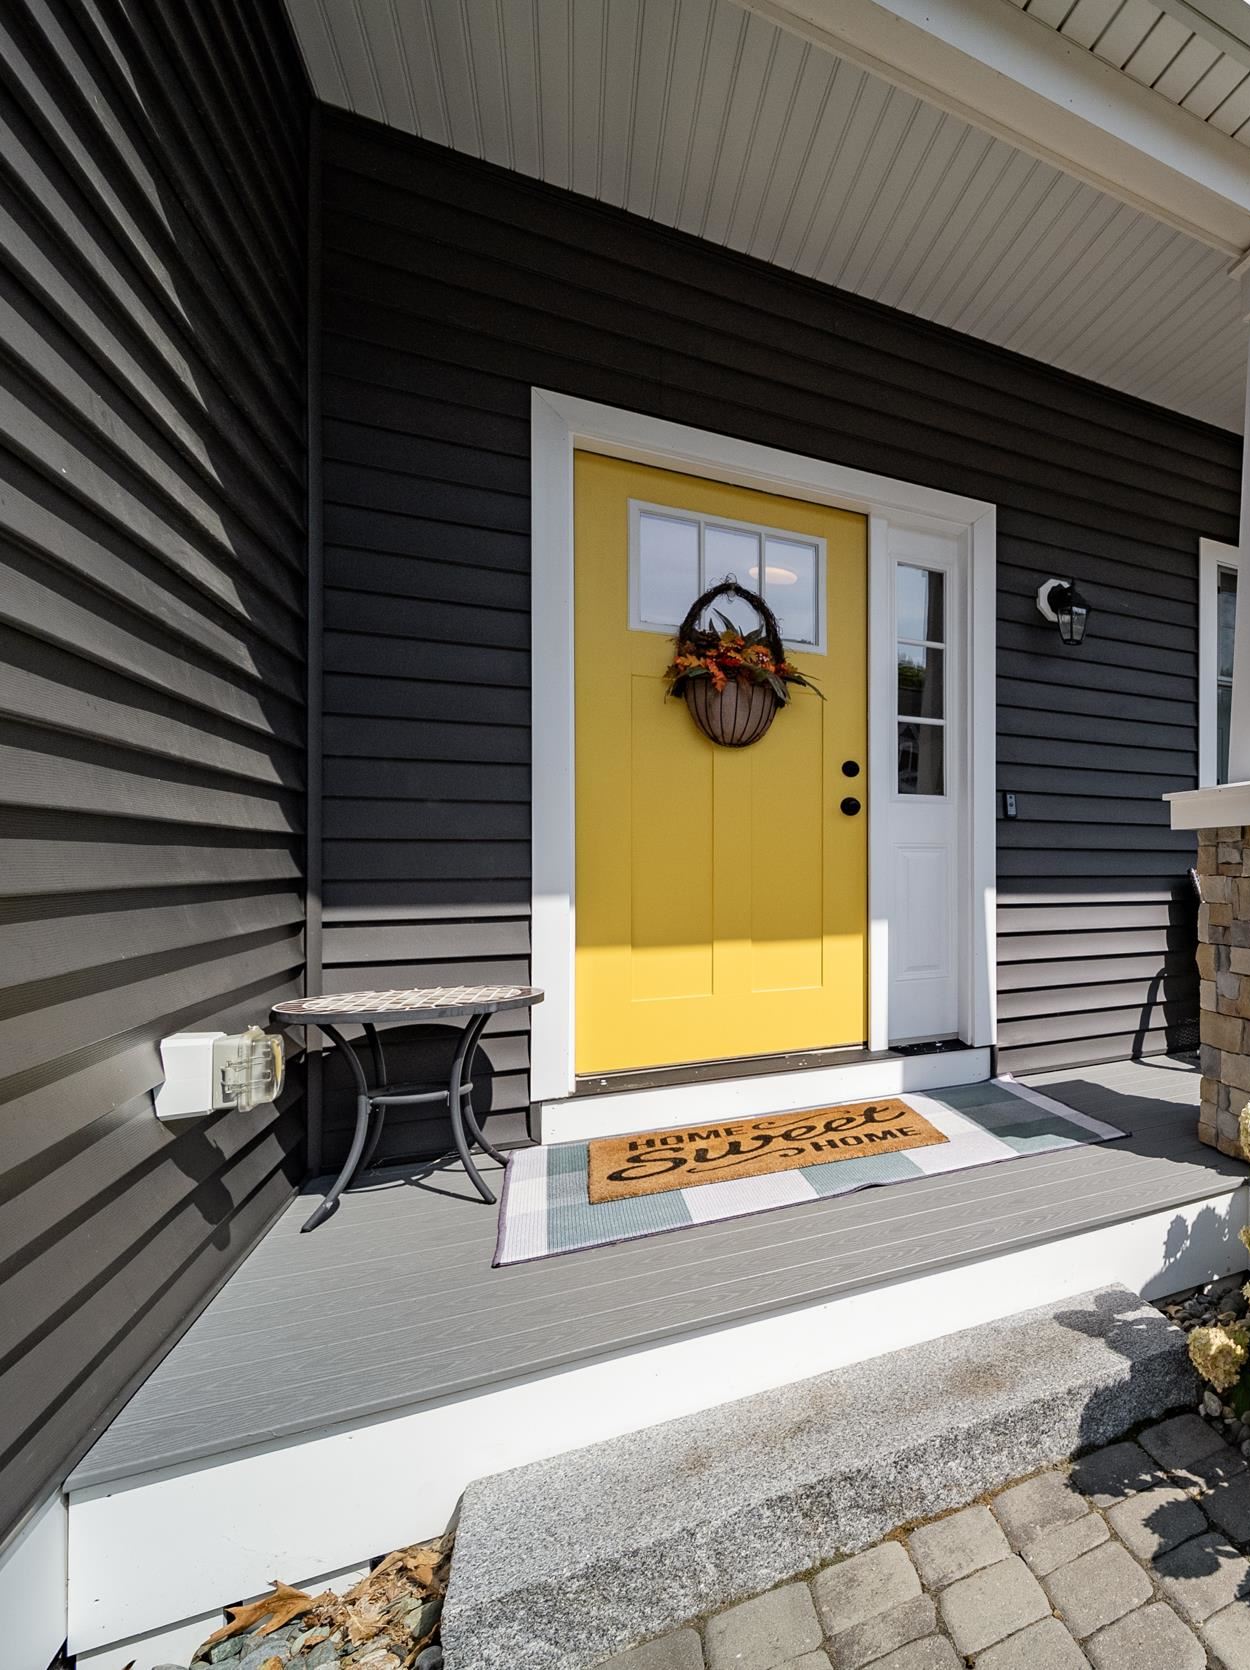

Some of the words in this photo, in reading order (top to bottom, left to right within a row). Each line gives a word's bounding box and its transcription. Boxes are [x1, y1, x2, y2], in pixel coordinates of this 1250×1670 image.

[607, 1105, 907, 1182] Sweet
[629, 1125, 748, 1152] HOME
[811, 1125, 922, 1152] HOME
